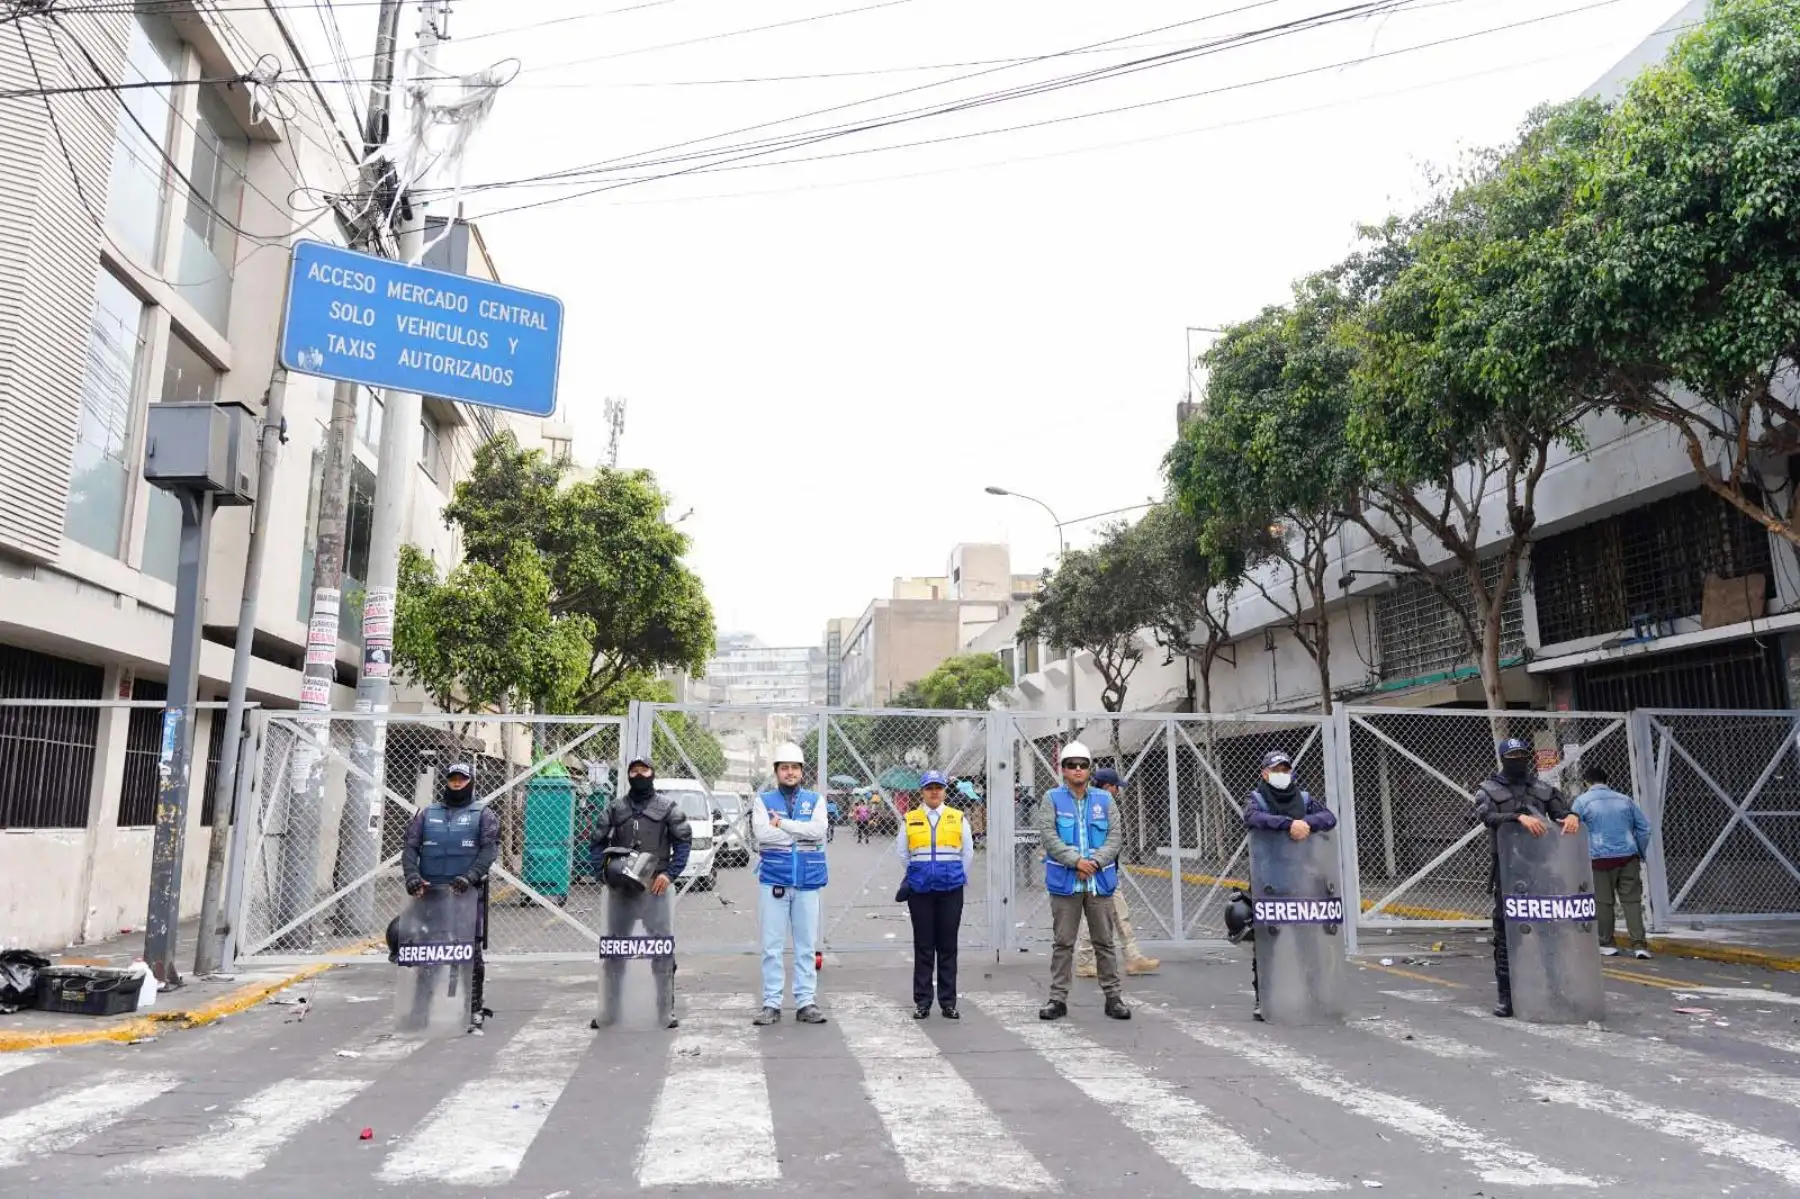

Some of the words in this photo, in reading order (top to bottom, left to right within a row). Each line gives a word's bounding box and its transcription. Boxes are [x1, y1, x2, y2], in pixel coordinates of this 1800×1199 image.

[308, 261, 376, 294] ACCESO
[387, 281, 469, 313] MERCADO
[479, 300, 548, 331] CENTRAL
[329, 301, 375, 327] SOLO
[396, 315, 489, 350] VEHICULOS
[508, 337, 519, 355] Y
[326, 333, 377, 361] TAXIS
[398, 349, 513, 387] AUTORIZADOS
[1255, 901, 1342, 921] SERENAZGO
[1506, 898, 1596, 919] SERENAZGO
[399, 943, 473, 962] SERENAZGO
[600, 939, 673, 955] SERENAZGO
